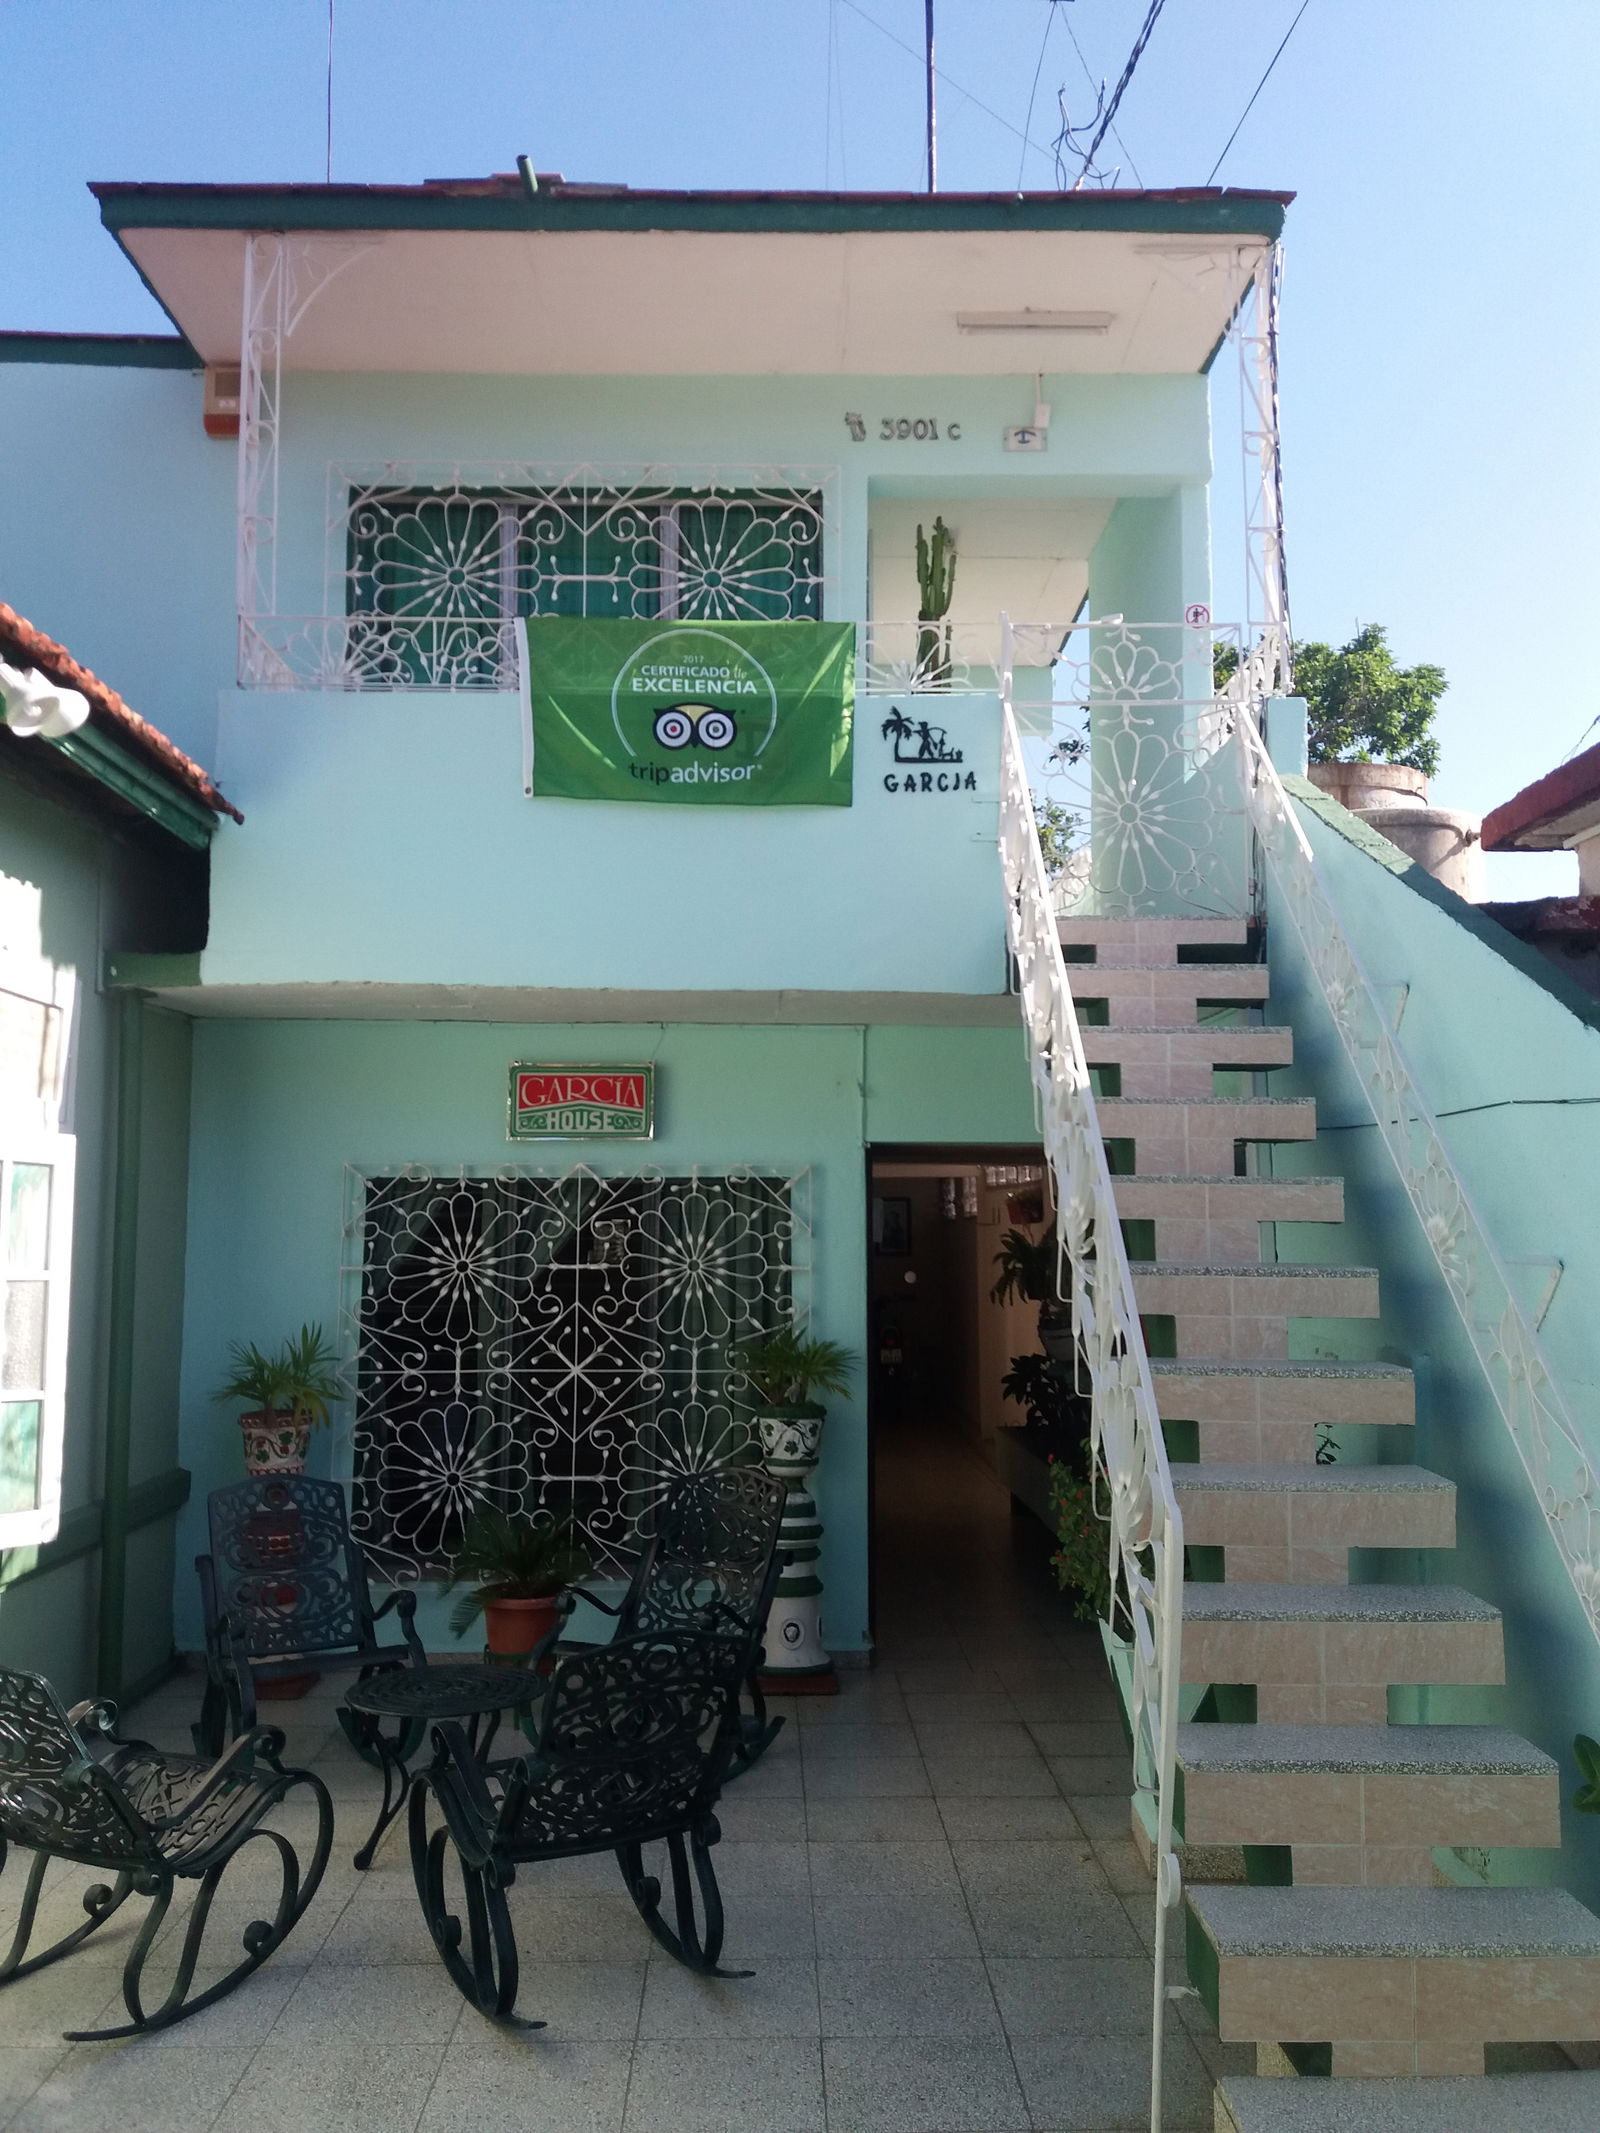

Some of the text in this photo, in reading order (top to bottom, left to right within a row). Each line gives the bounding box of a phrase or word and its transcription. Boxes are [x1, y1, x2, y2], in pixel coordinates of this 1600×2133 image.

[879, 417, 939, 441] 3901
[682, 655, 705, 664] 2017
[641, 665, 730, 679] CERTIFICADO
[632, 678, 758, 695] EXCELENCIA
[521, 1077, 641, 1107] GARCÍA
[546, 1111, 615, 1131] HOUSE
